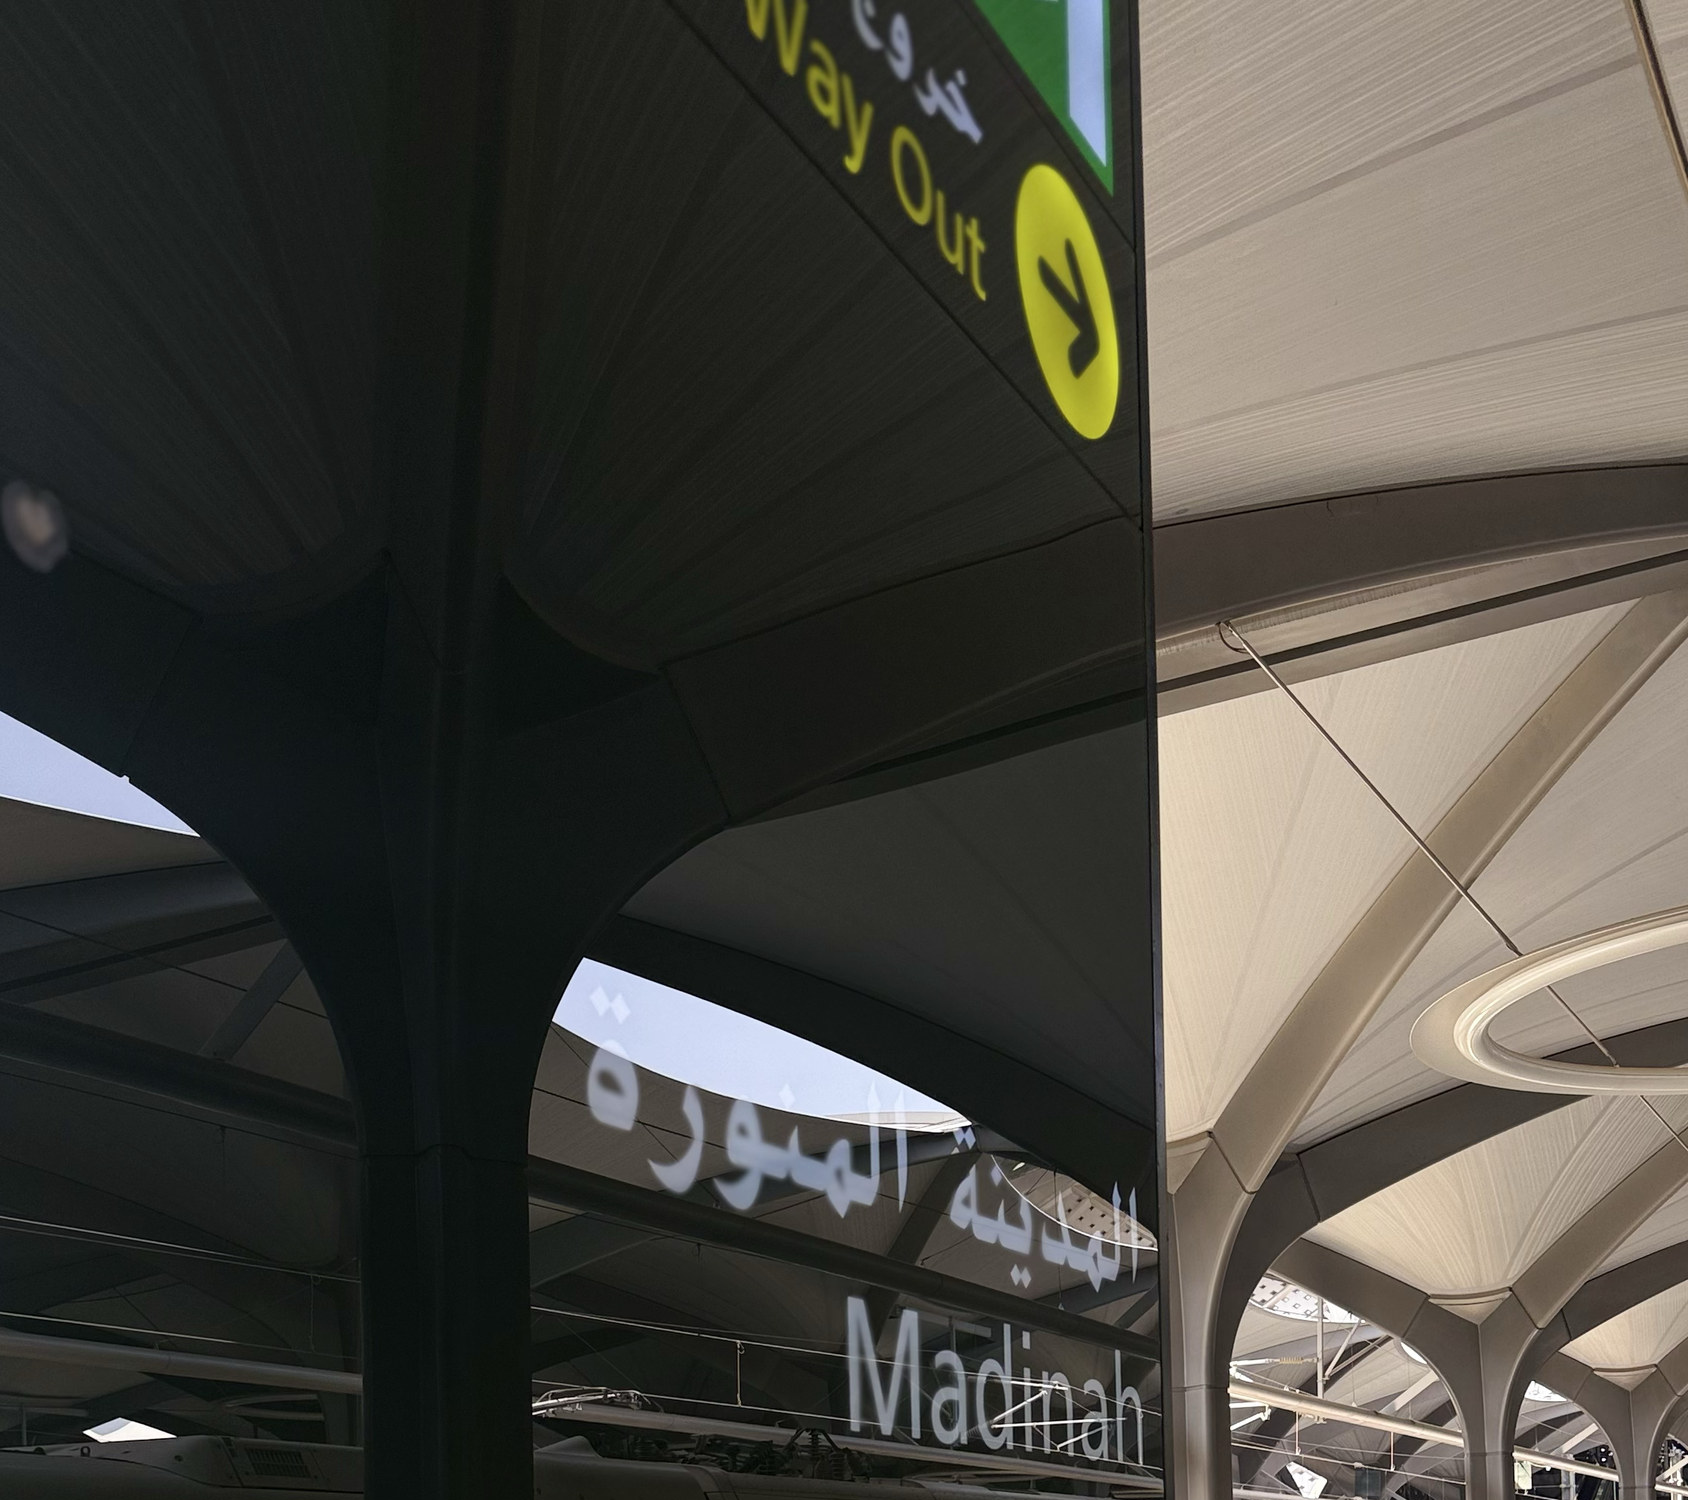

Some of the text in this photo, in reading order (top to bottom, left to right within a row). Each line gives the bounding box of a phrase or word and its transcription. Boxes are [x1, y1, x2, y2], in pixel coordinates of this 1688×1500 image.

[745, 0, 986, 301] Way Out
[587, 985, 1139, 1293] المدينة المنورة
[847, 1296, 1144, 1466] Madinah
